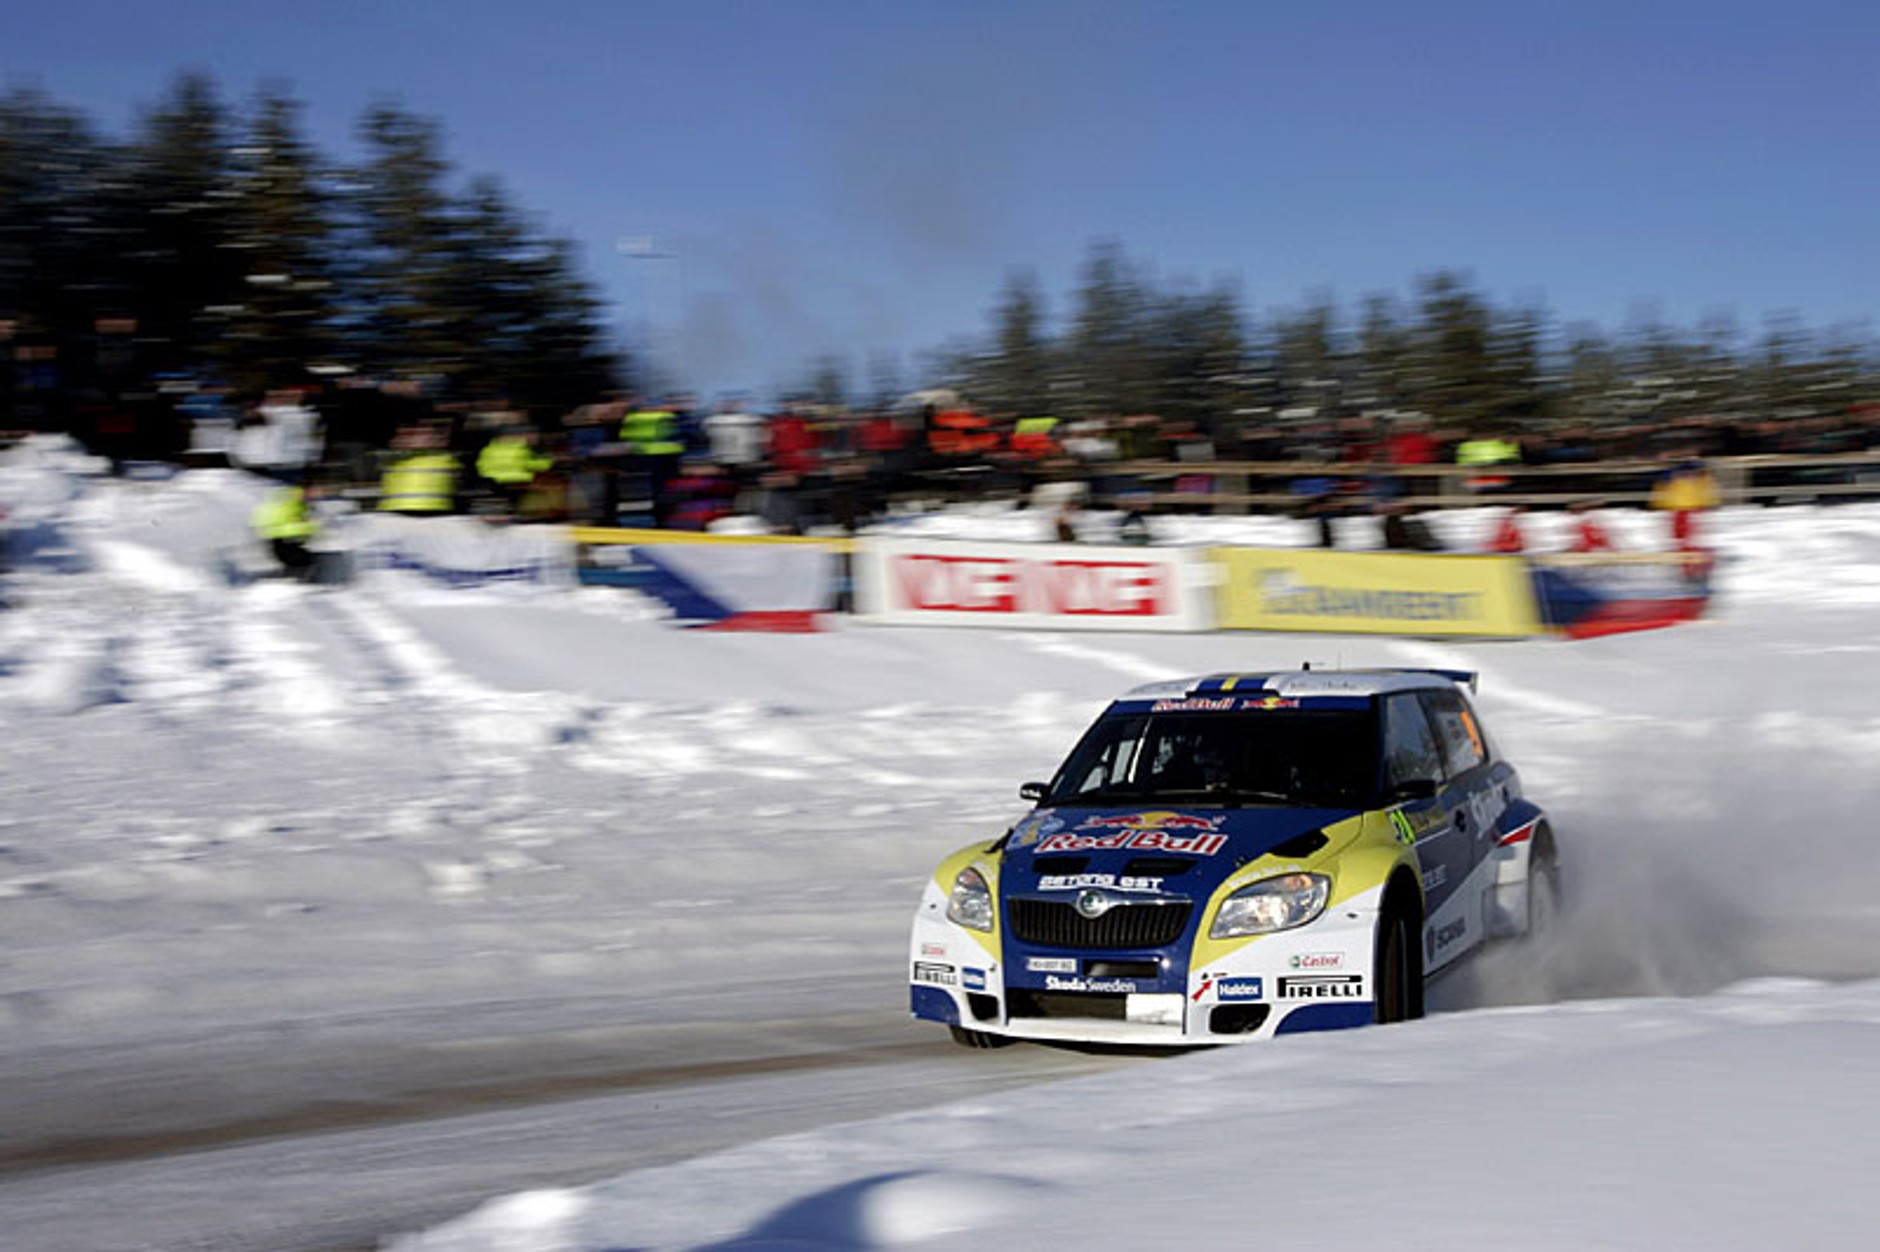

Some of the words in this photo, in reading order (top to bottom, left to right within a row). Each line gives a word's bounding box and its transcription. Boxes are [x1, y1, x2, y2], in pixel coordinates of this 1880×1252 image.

[1034, 829, 1129, 854] Red
[1126, 831, 1229, 856] Bull
[1276, 974, 1363, 998] PIRELLI
